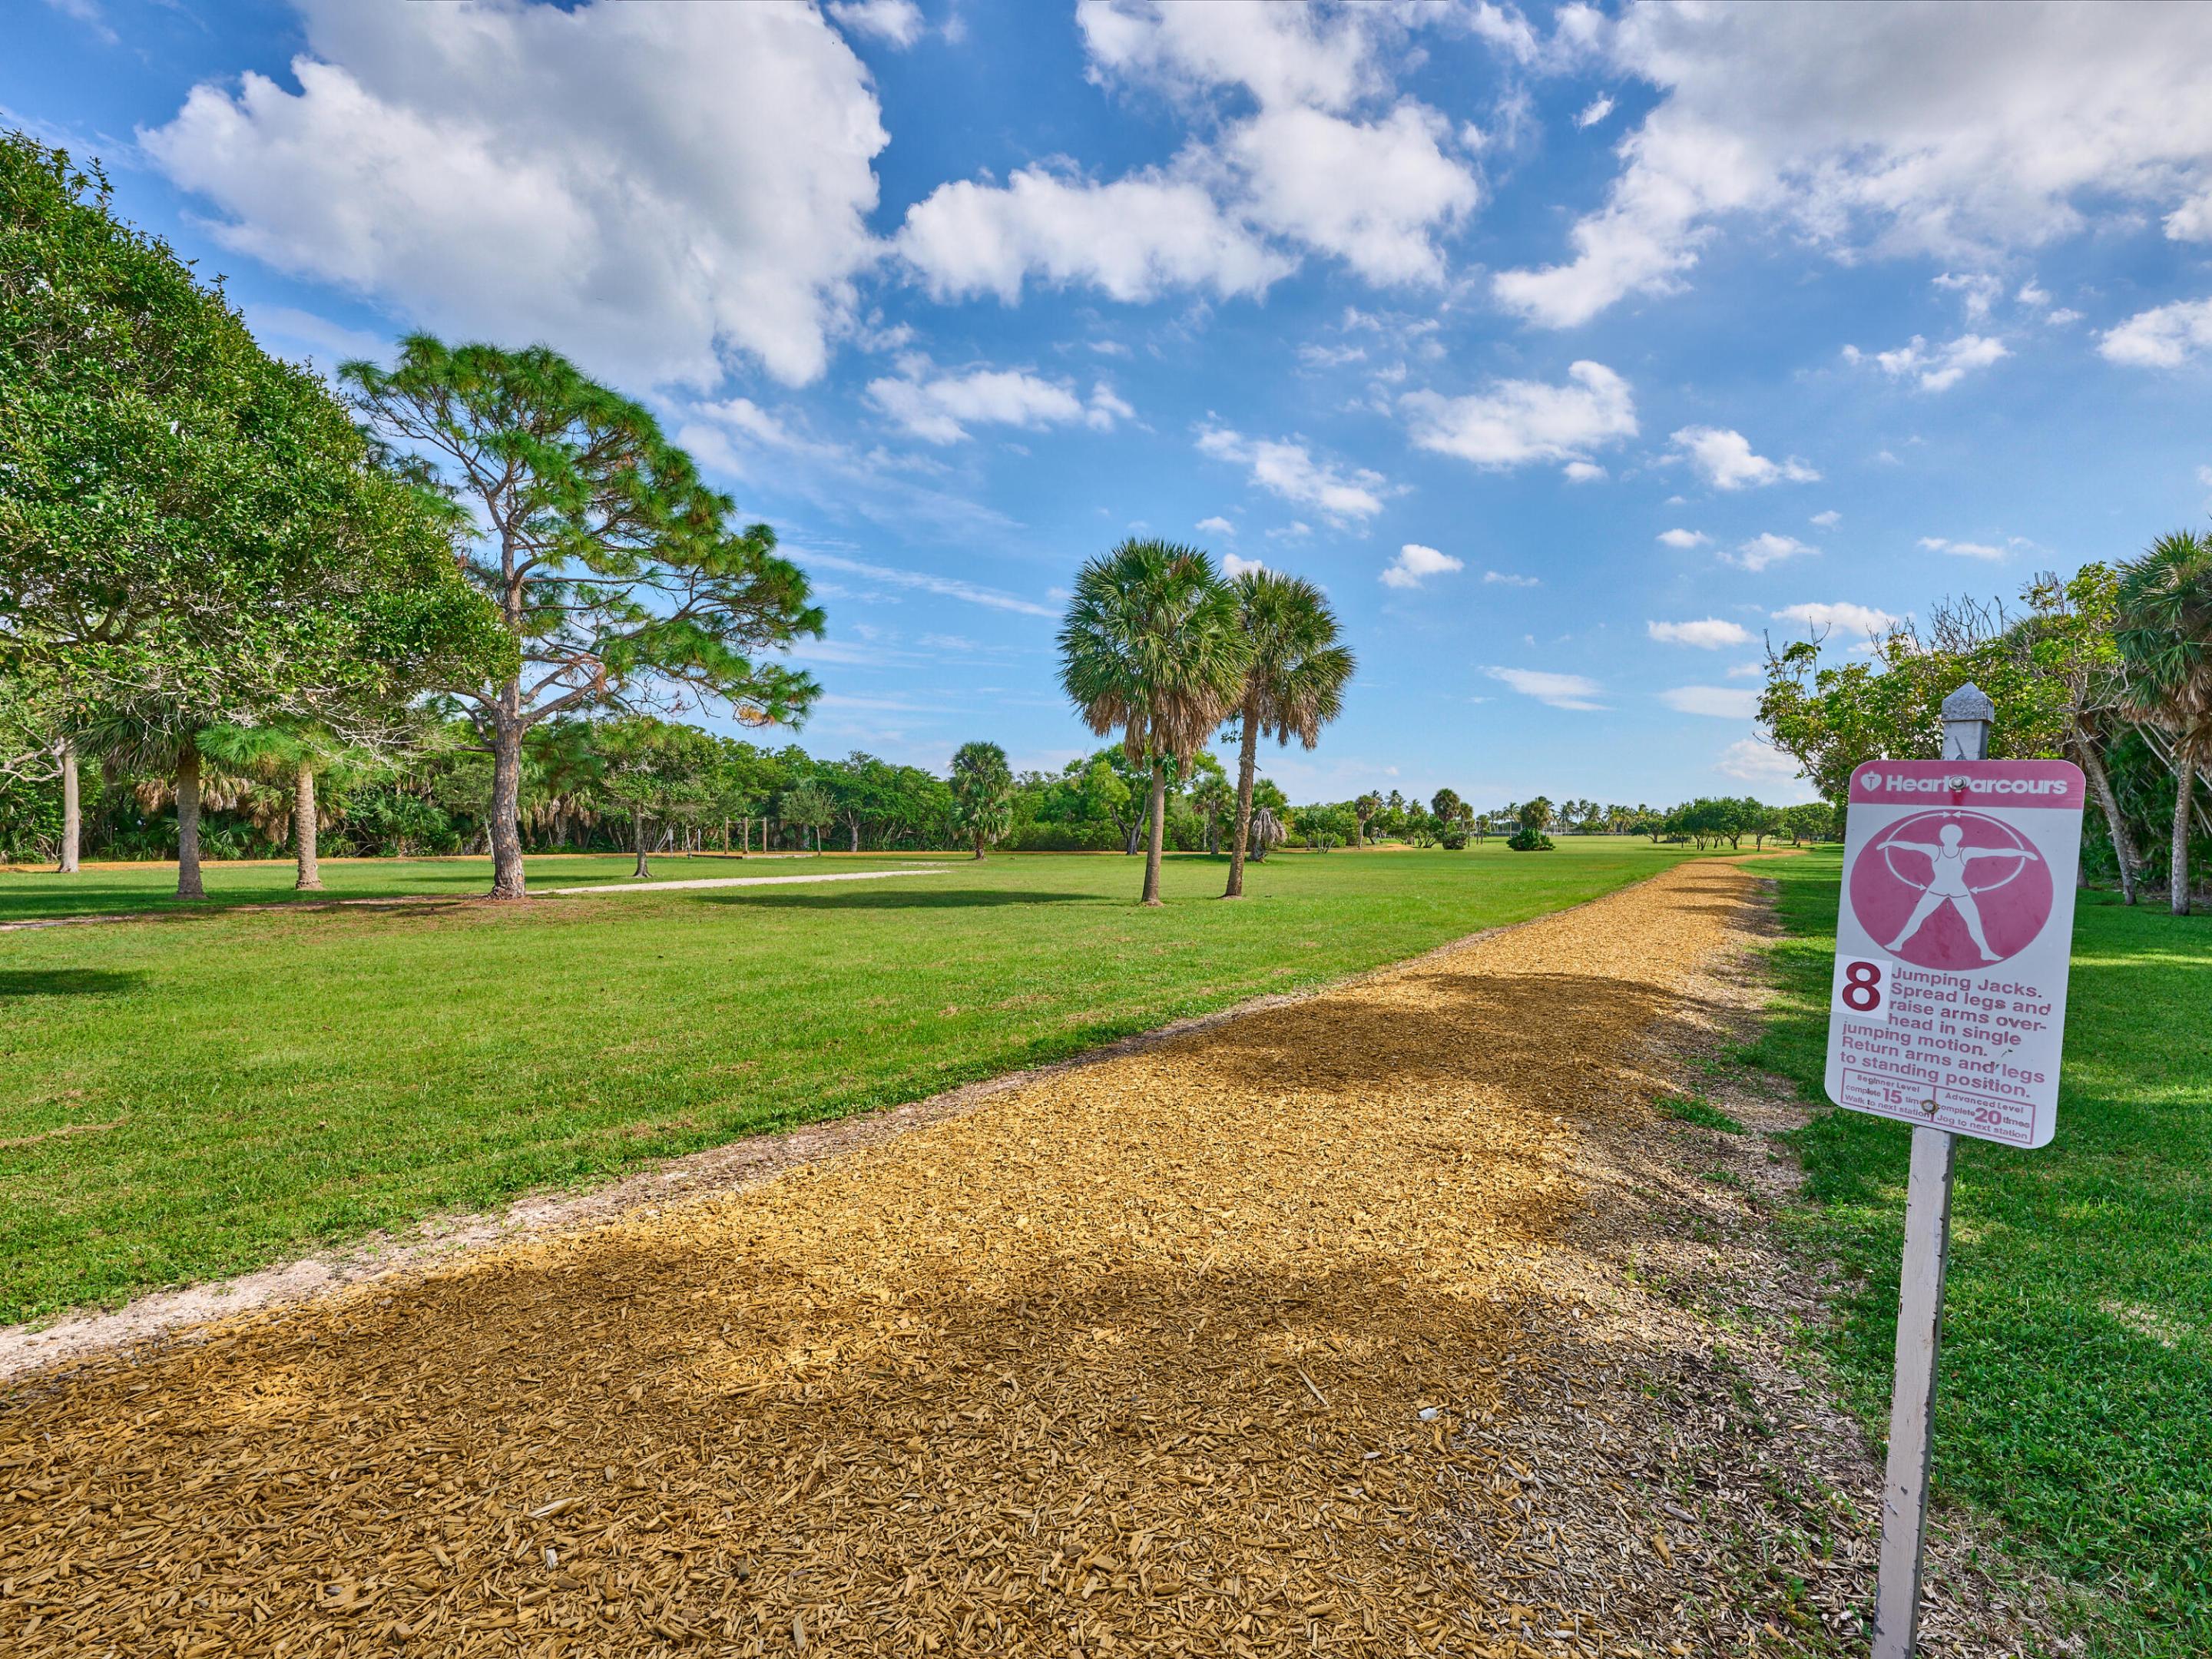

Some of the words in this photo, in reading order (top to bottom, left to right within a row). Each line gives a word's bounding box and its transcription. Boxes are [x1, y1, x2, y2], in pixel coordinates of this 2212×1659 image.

[1842, 961, 1882, 1012] 8
[1892, 967, 1971, 992] Jumping
[1978, 979, 2042, 998] Jacks.
[1891, 982, 1958, 1003] Spread
[1964, 992, 2006, 1011] legs
[2012, 1002, 2051, 1015] and
[1888, 1013, 1933, 1031] head
[1939, 1021, 1956, 1035] in
[1962, 1026, 2022, 1045] single
[1889, 1000, 1934, 1015] raise
[1940, 1008, 1989, 1024] arms
[1996, 1015, 2047, 1031] over-
[1842, 1021, 1912, 1046] jumping
[1918, 1036, 1988, 1056] motion.
[1840, 1051, 1856, 1065] to
[1862, 1057, 1939, 1083] standing
[1945, 1073, 2030, 1098] position.
[1842, 1036, 1899, 1057] Return
[1905, 1049, 1952, 1066] arms
[1958, 1058, 1995, 1074] and
[2002, 1064, 2045, 1084] legs
[1846, 1084, 1881, 1098] complete
[1883, 1088, 1903, 1104] 15
[1857, 1075, 1895, 1088] Beginner
[1896, 1082, 1920, 1093] Level
[1845, 1094, 1866, 1104] Walk
[1878, 1102, 1897, 1113] next
[1899, 1107, 1930, 1118] station
[1945, 1092, 1995, 1108] Advanced
[1997, 1103, 2024, 1113] Level
[1975, 1107, 2002, 1125] 20
[2002, 1116, 2030, 1128] times
[1937, 1114, 1955, 1125] Jog
[1959, 1118, 1967, 1127] to
[1970, 1121, 1991, 1132] next
[1994, 1127, 2028, 1140] station
